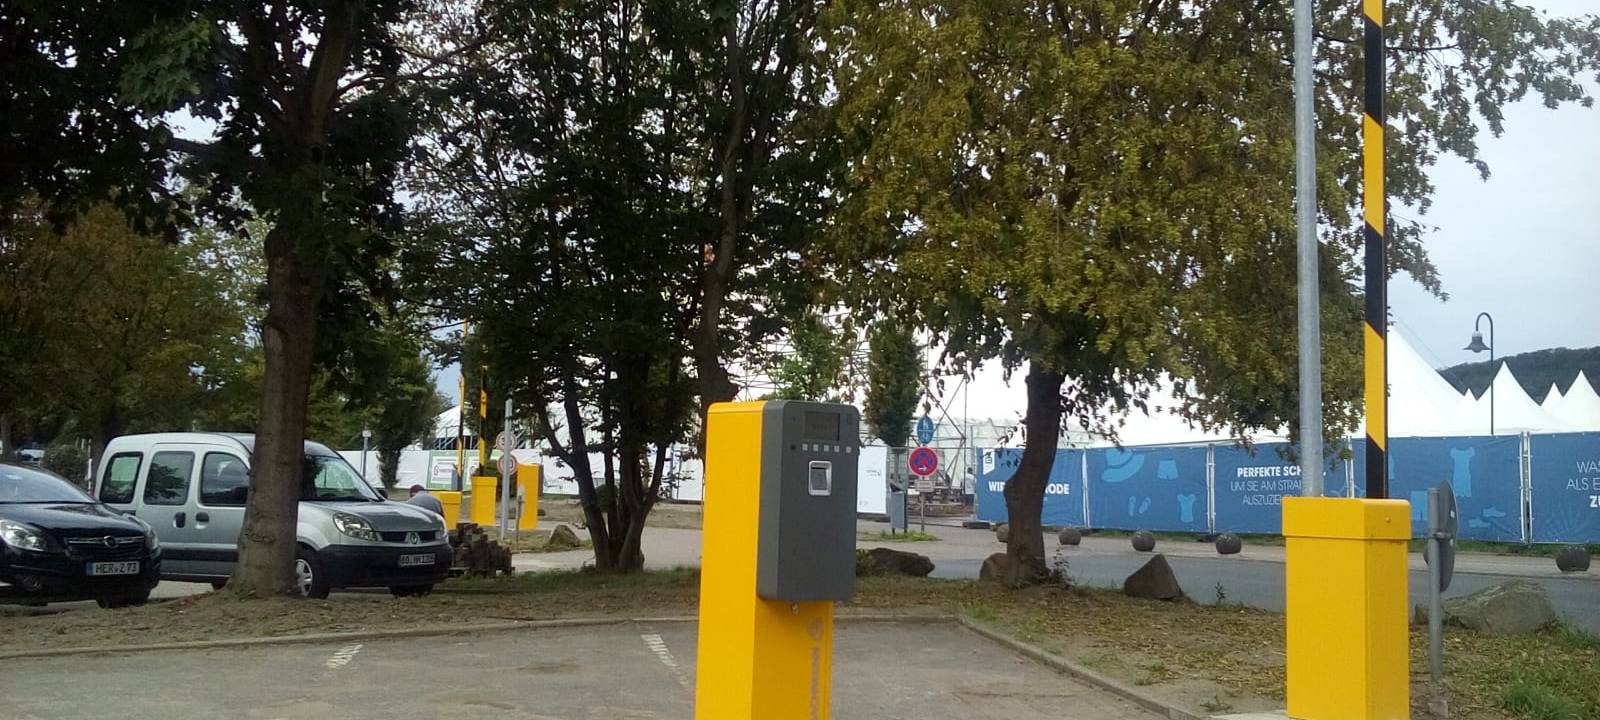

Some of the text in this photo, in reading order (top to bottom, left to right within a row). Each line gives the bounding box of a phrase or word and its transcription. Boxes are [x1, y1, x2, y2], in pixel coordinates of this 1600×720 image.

[1237, 466, 1281, 478] PERFEKTE
[1045, 483, 1070, 495] ODE
[1230, 481, 1245, 492] UM
[1261, 480, 1276, 492] AM
[1566, 477, 1589, 491] ALS
[96, 563, 113, 574] HER
